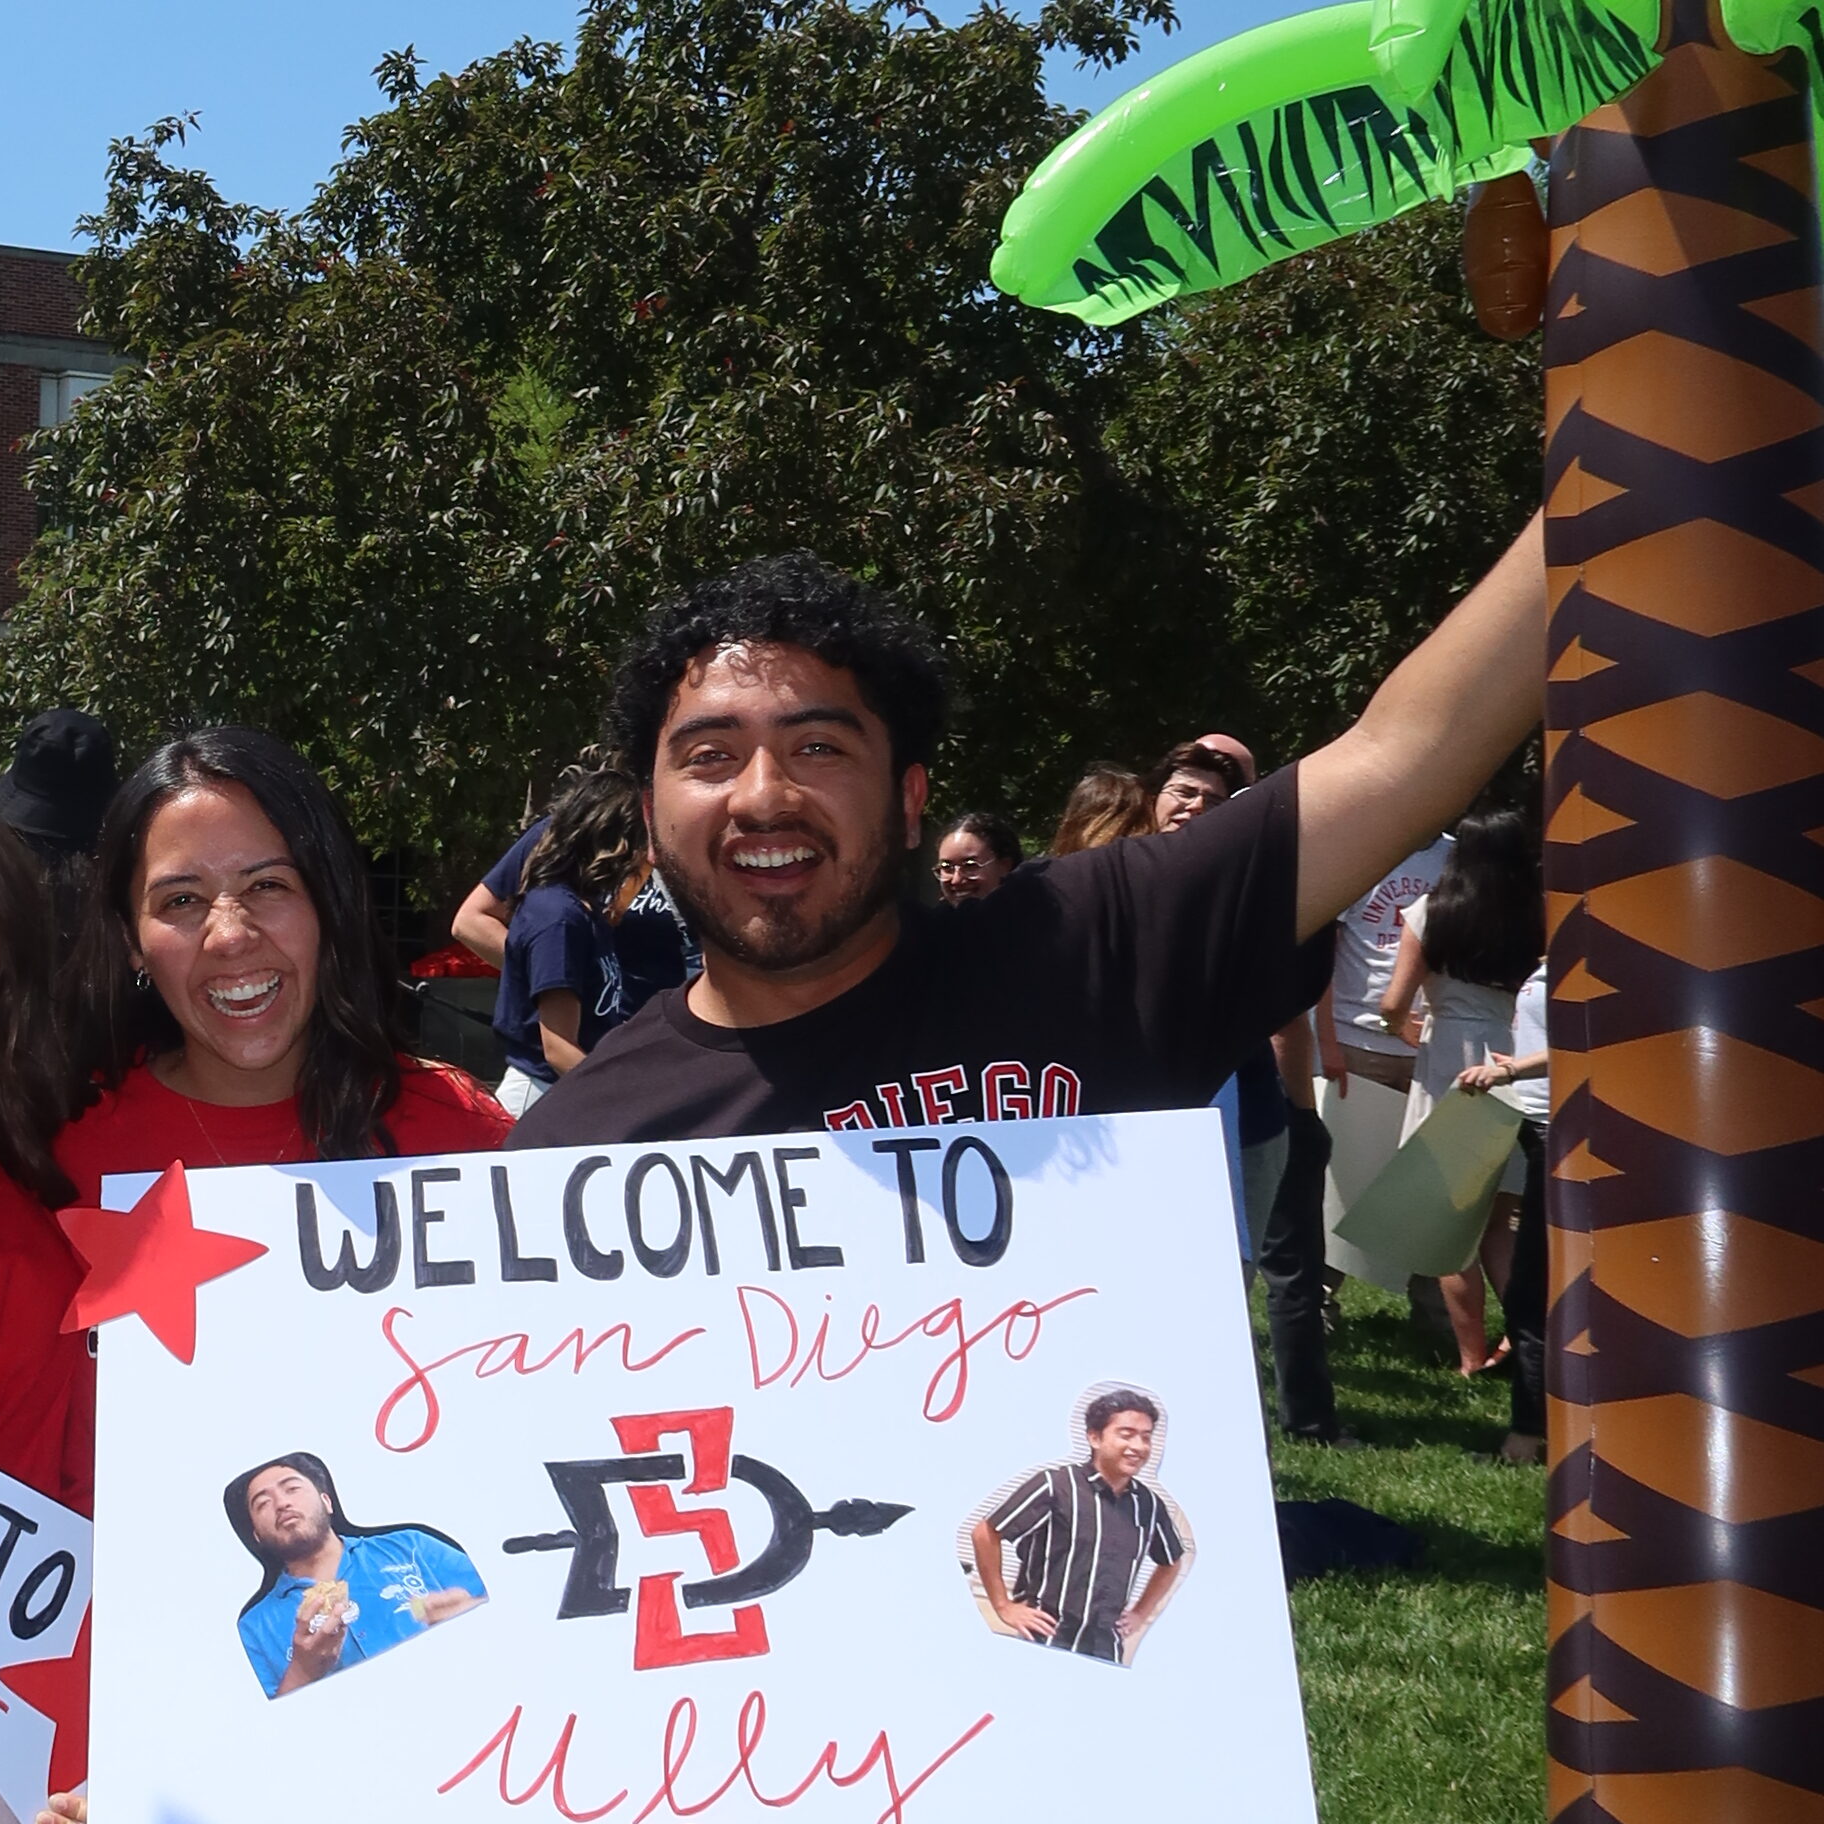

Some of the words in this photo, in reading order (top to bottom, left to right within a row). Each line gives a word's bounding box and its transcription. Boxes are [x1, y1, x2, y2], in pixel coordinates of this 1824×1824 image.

[295, 1146, 845, 1295] WELCOME
[871, 1134, 1014, 1268] TO
[374, 1306, 704, 1453] San
[737, 1286, 1099, 1423] Diego
